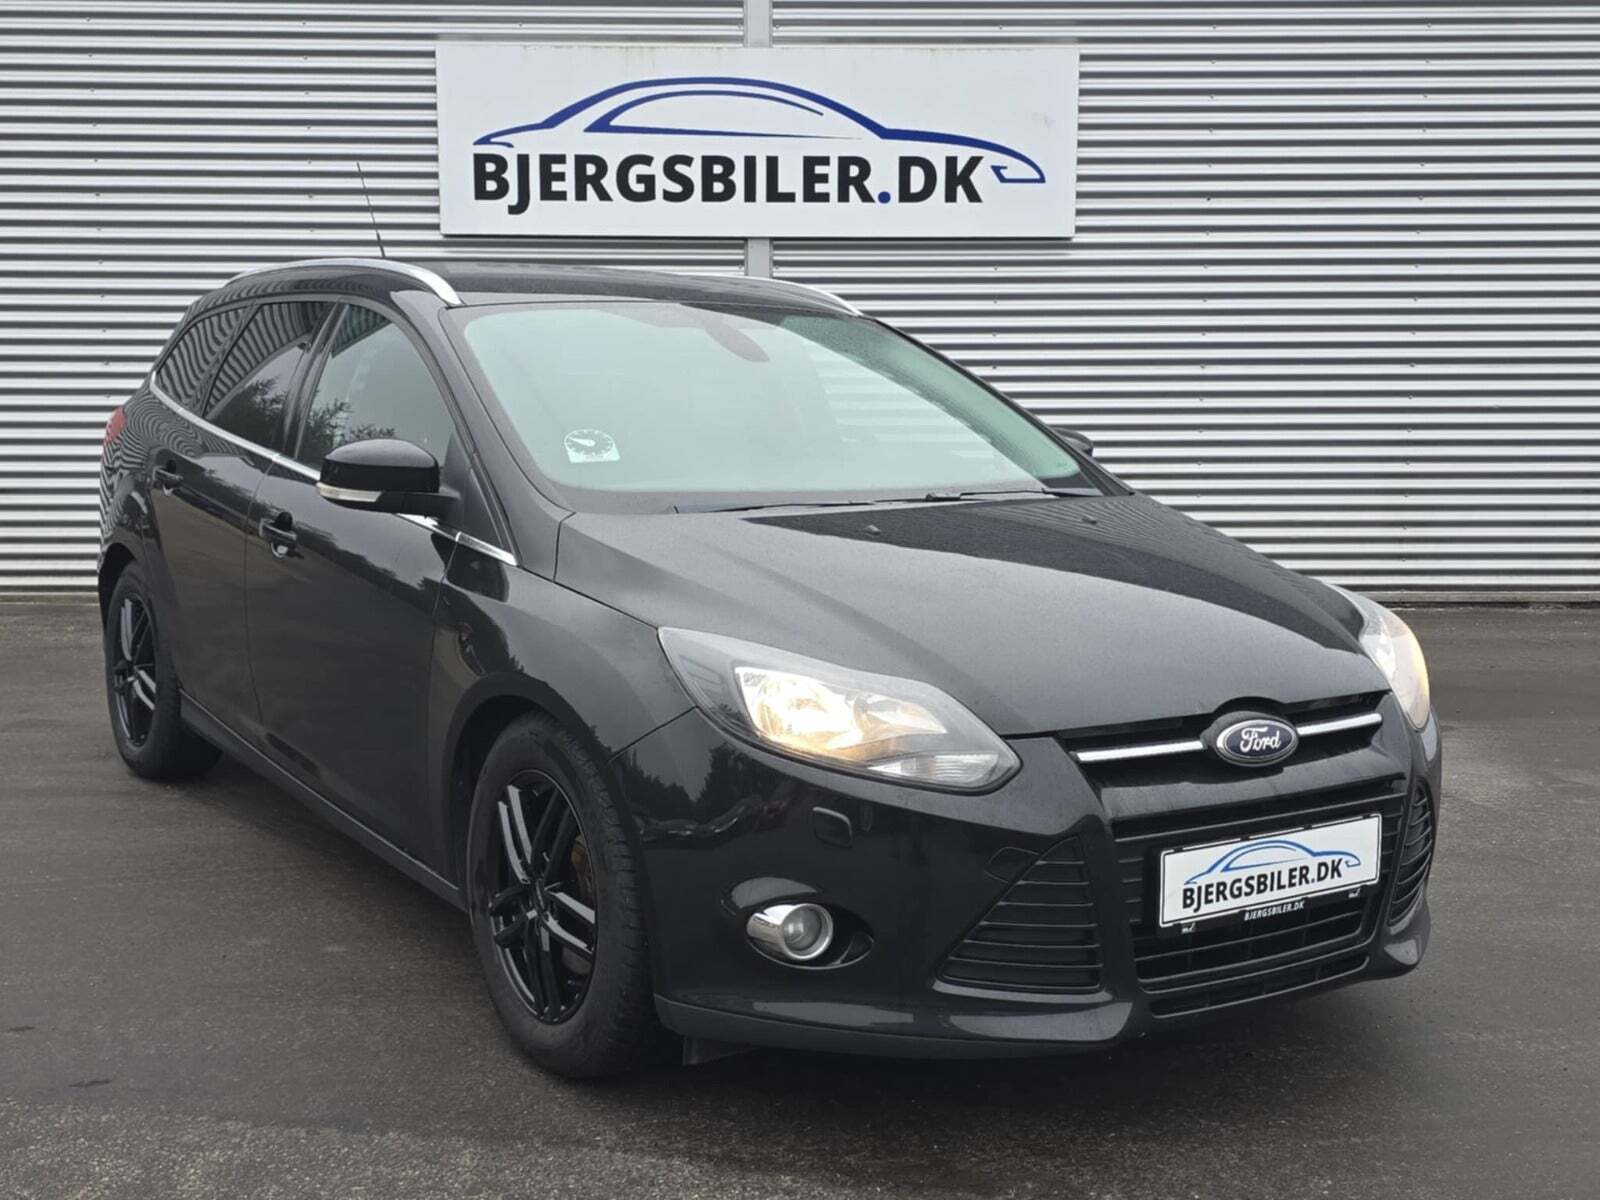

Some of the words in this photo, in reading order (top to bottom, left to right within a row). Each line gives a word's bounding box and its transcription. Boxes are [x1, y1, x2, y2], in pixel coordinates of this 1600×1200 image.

[473, 152, 984, 215] BJERGSBILER.DK
[1240, 726, 1281, 753] Ford
[1182, 857, 1344, 913] BJERGSBILER.DK
[1244, 900, 1305, 921] BJERGSBILER.DK
